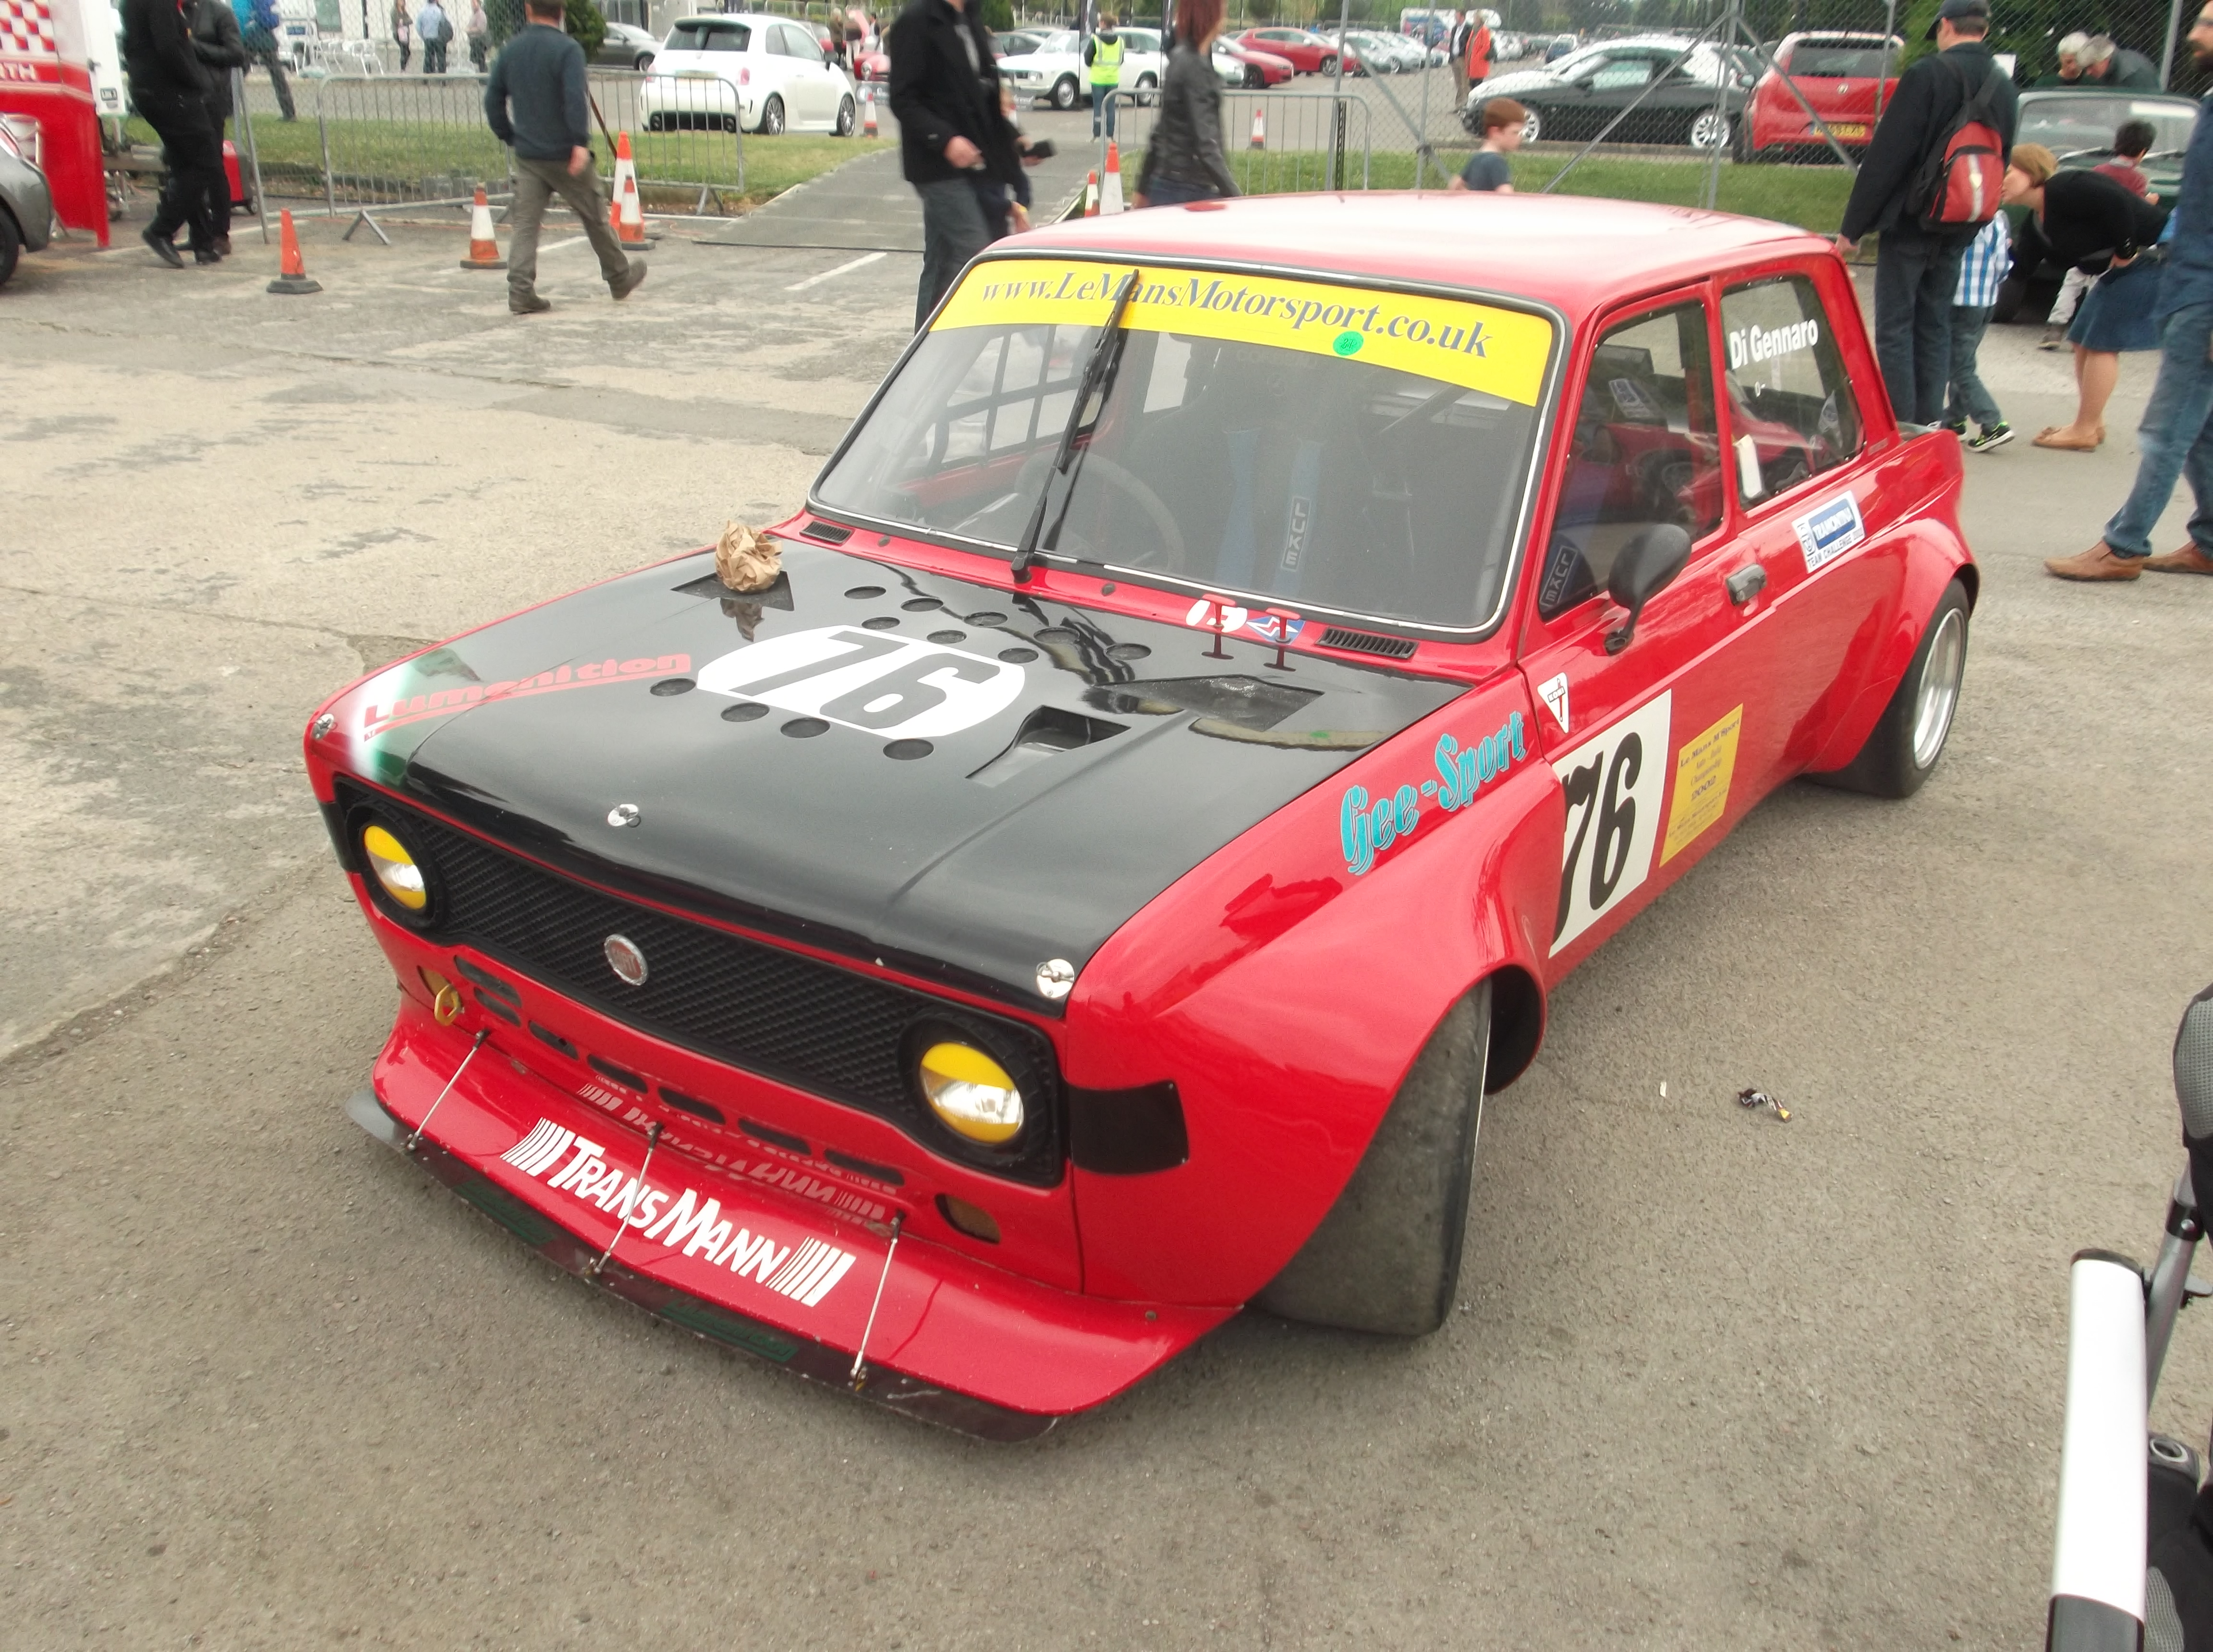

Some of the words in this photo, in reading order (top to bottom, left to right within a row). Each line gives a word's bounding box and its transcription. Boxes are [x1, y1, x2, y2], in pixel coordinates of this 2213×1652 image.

[982, 270, 1494, 358] www.LeMansMotorsport.co.uk
[1729, 328, 1748, 370] Di
[1750, 319, 1819, 362] Gennaro
[1286, 502, 1306, 566] LUKE
[1545, 552, 1569, 602] LUKE
[364, 653, 692, 728] Lumenition
[728, 630, 1001, 730] 76
[1547, 687, 1565, 703] KONI
[1691, 741, 1712, 759] Mans
[1340, 711, 1527, 875] Gee-Sport
[1554, 731, 1643, 943] 76
